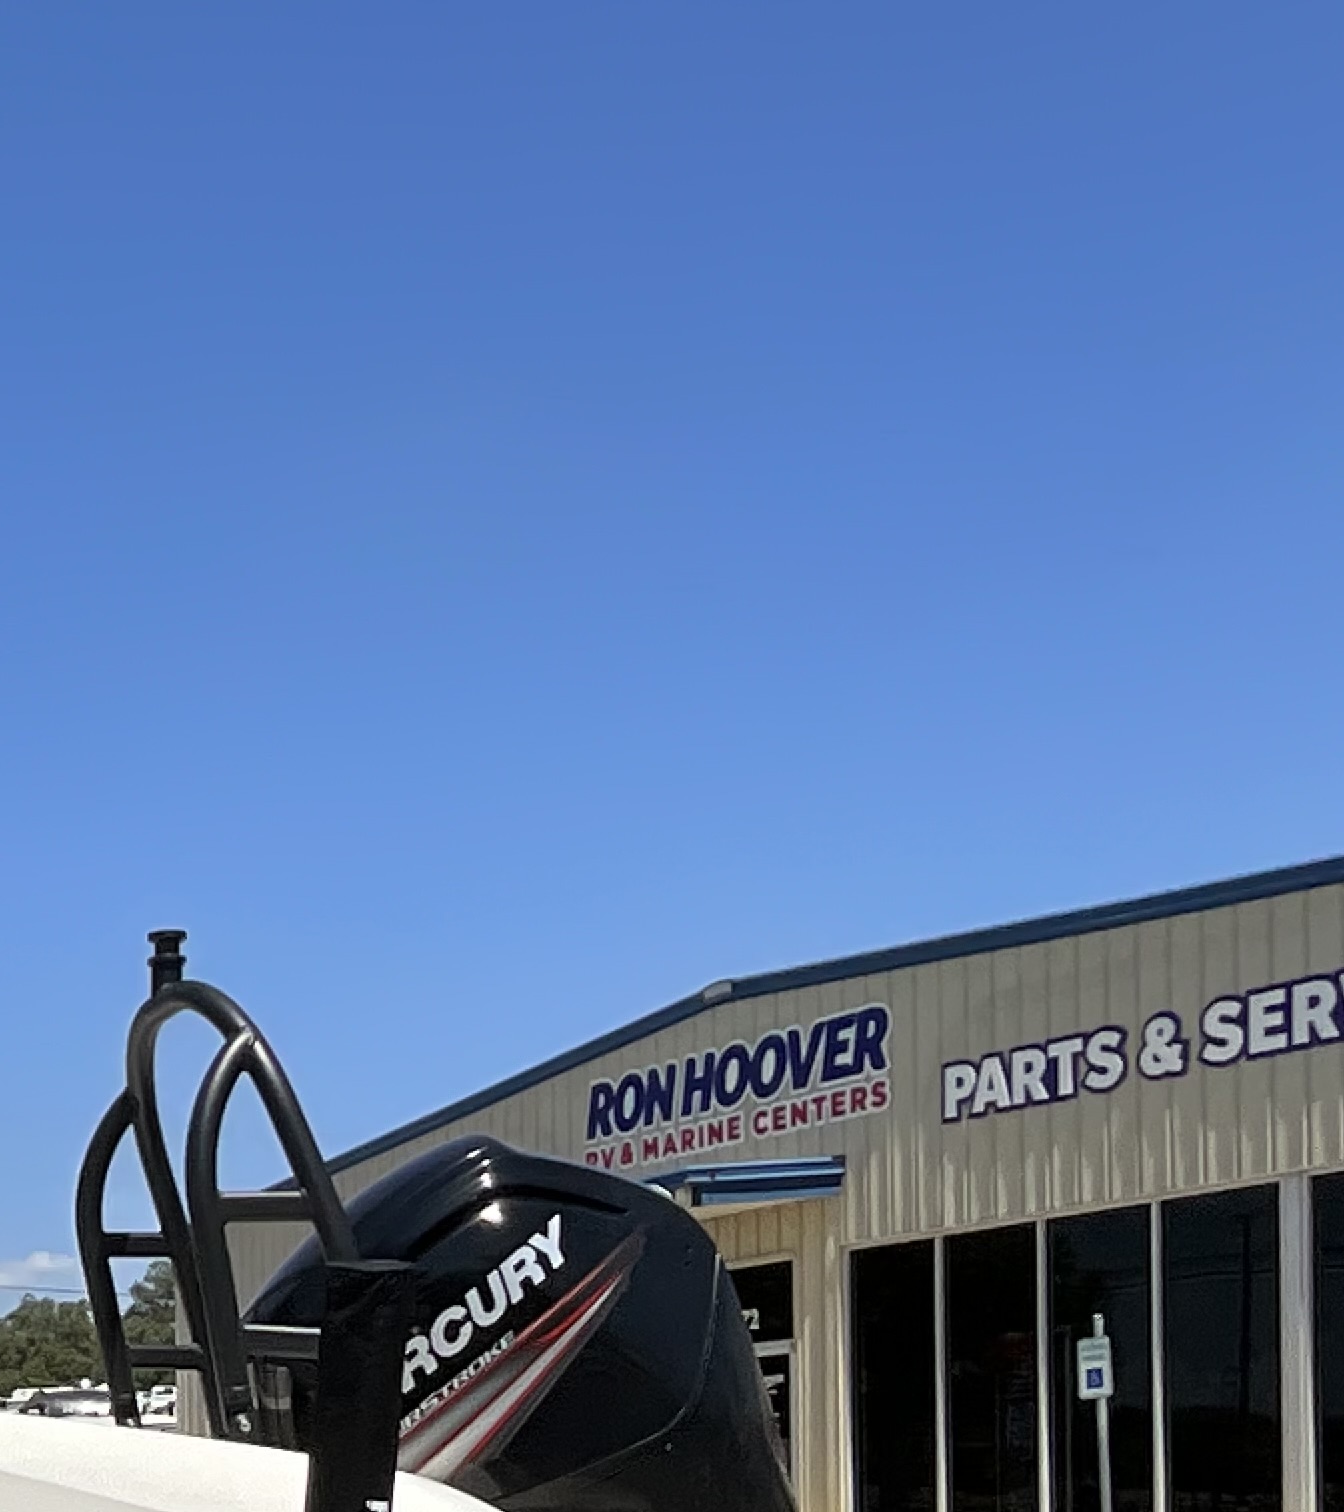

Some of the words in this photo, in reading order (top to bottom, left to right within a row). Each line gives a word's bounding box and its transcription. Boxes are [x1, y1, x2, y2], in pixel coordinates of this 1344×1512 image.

[587, 1063, 677, 1140] RON
[680, 1007, 889, 1117] HOOVER
[942, 1024, 1127, 1123] PARTS
[1137, 1010, 1189, 1079] &
[1198, 967, 1344, 1066] SER
[620, 1142, 633, 1166] &
[642, 1115, 742, 1161] MARINE
[753, 1080, 888, 1135] CENTERS
